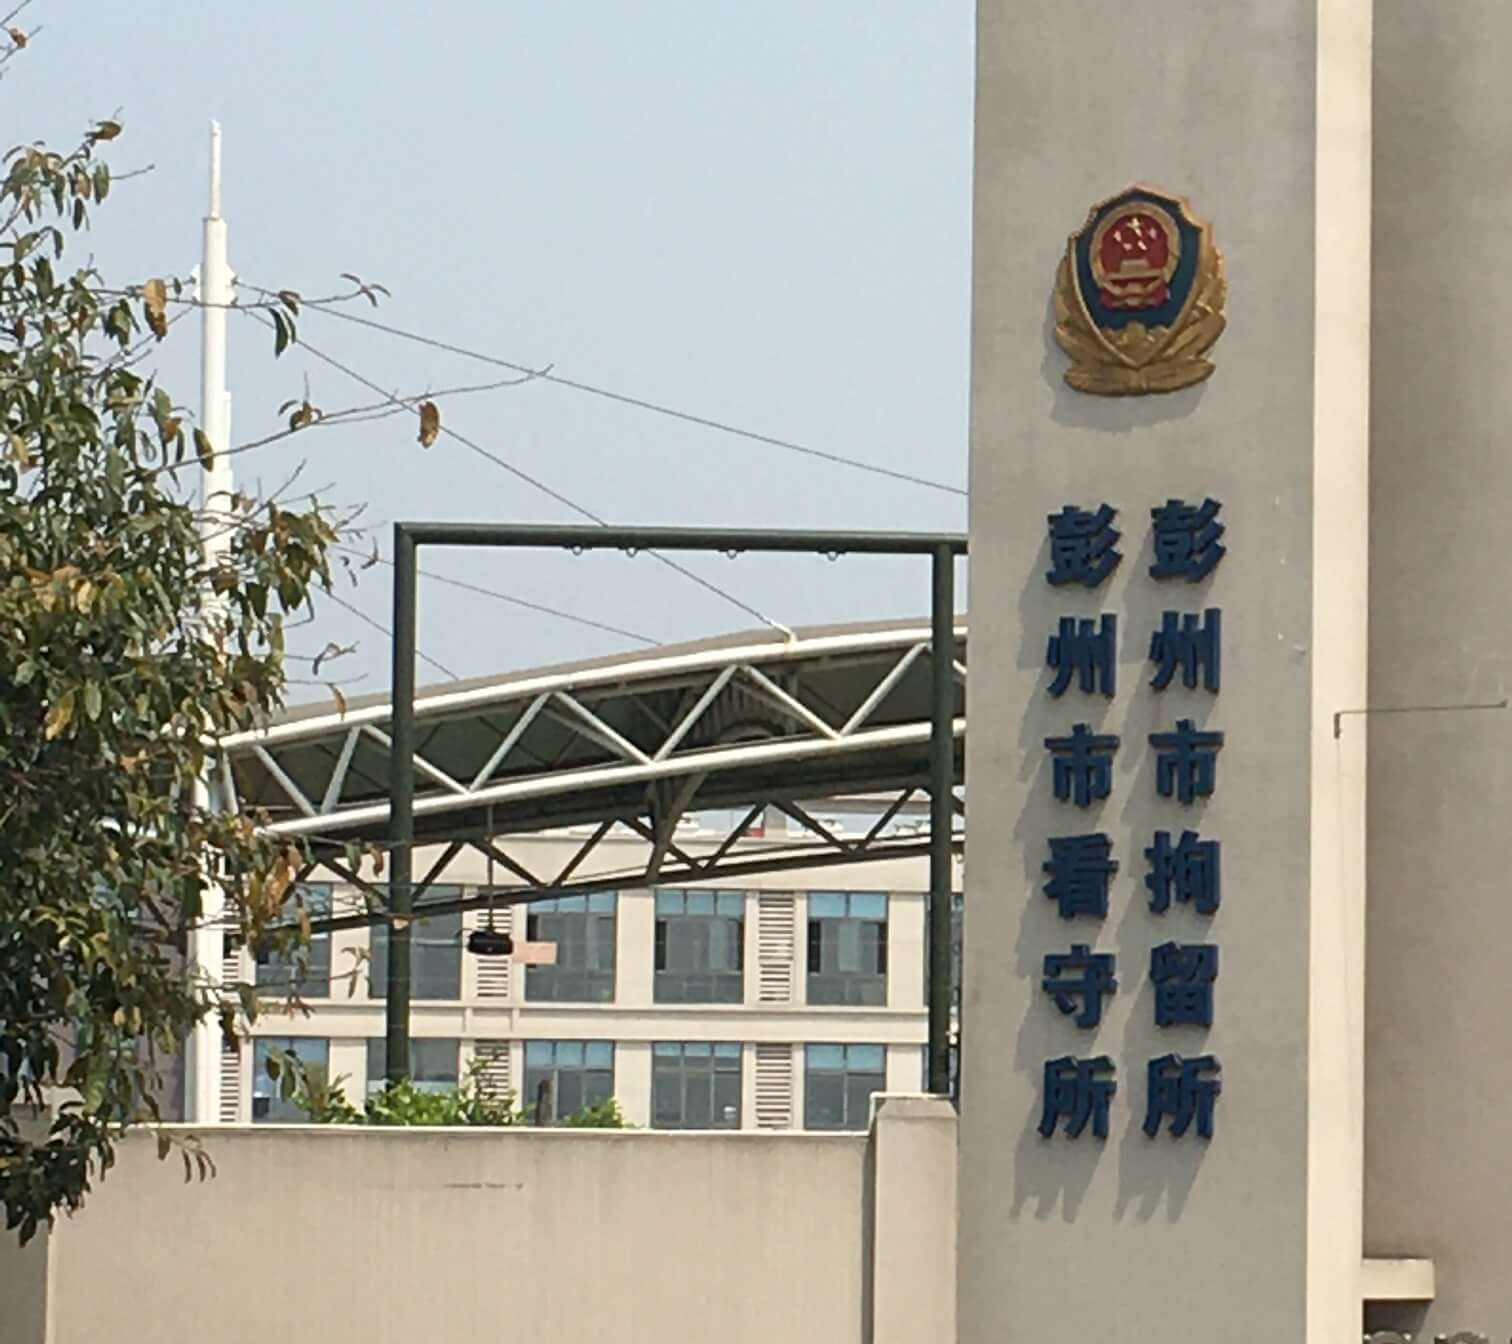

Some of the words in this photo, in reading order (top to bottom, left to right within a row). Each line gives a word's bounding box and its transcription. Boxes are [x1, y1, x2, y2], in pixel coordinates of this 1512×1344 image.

[1038, 502, 1122, 1140] 彭州市看守所
[1142, 497, 1227, 1140] 彭州市拘留所
